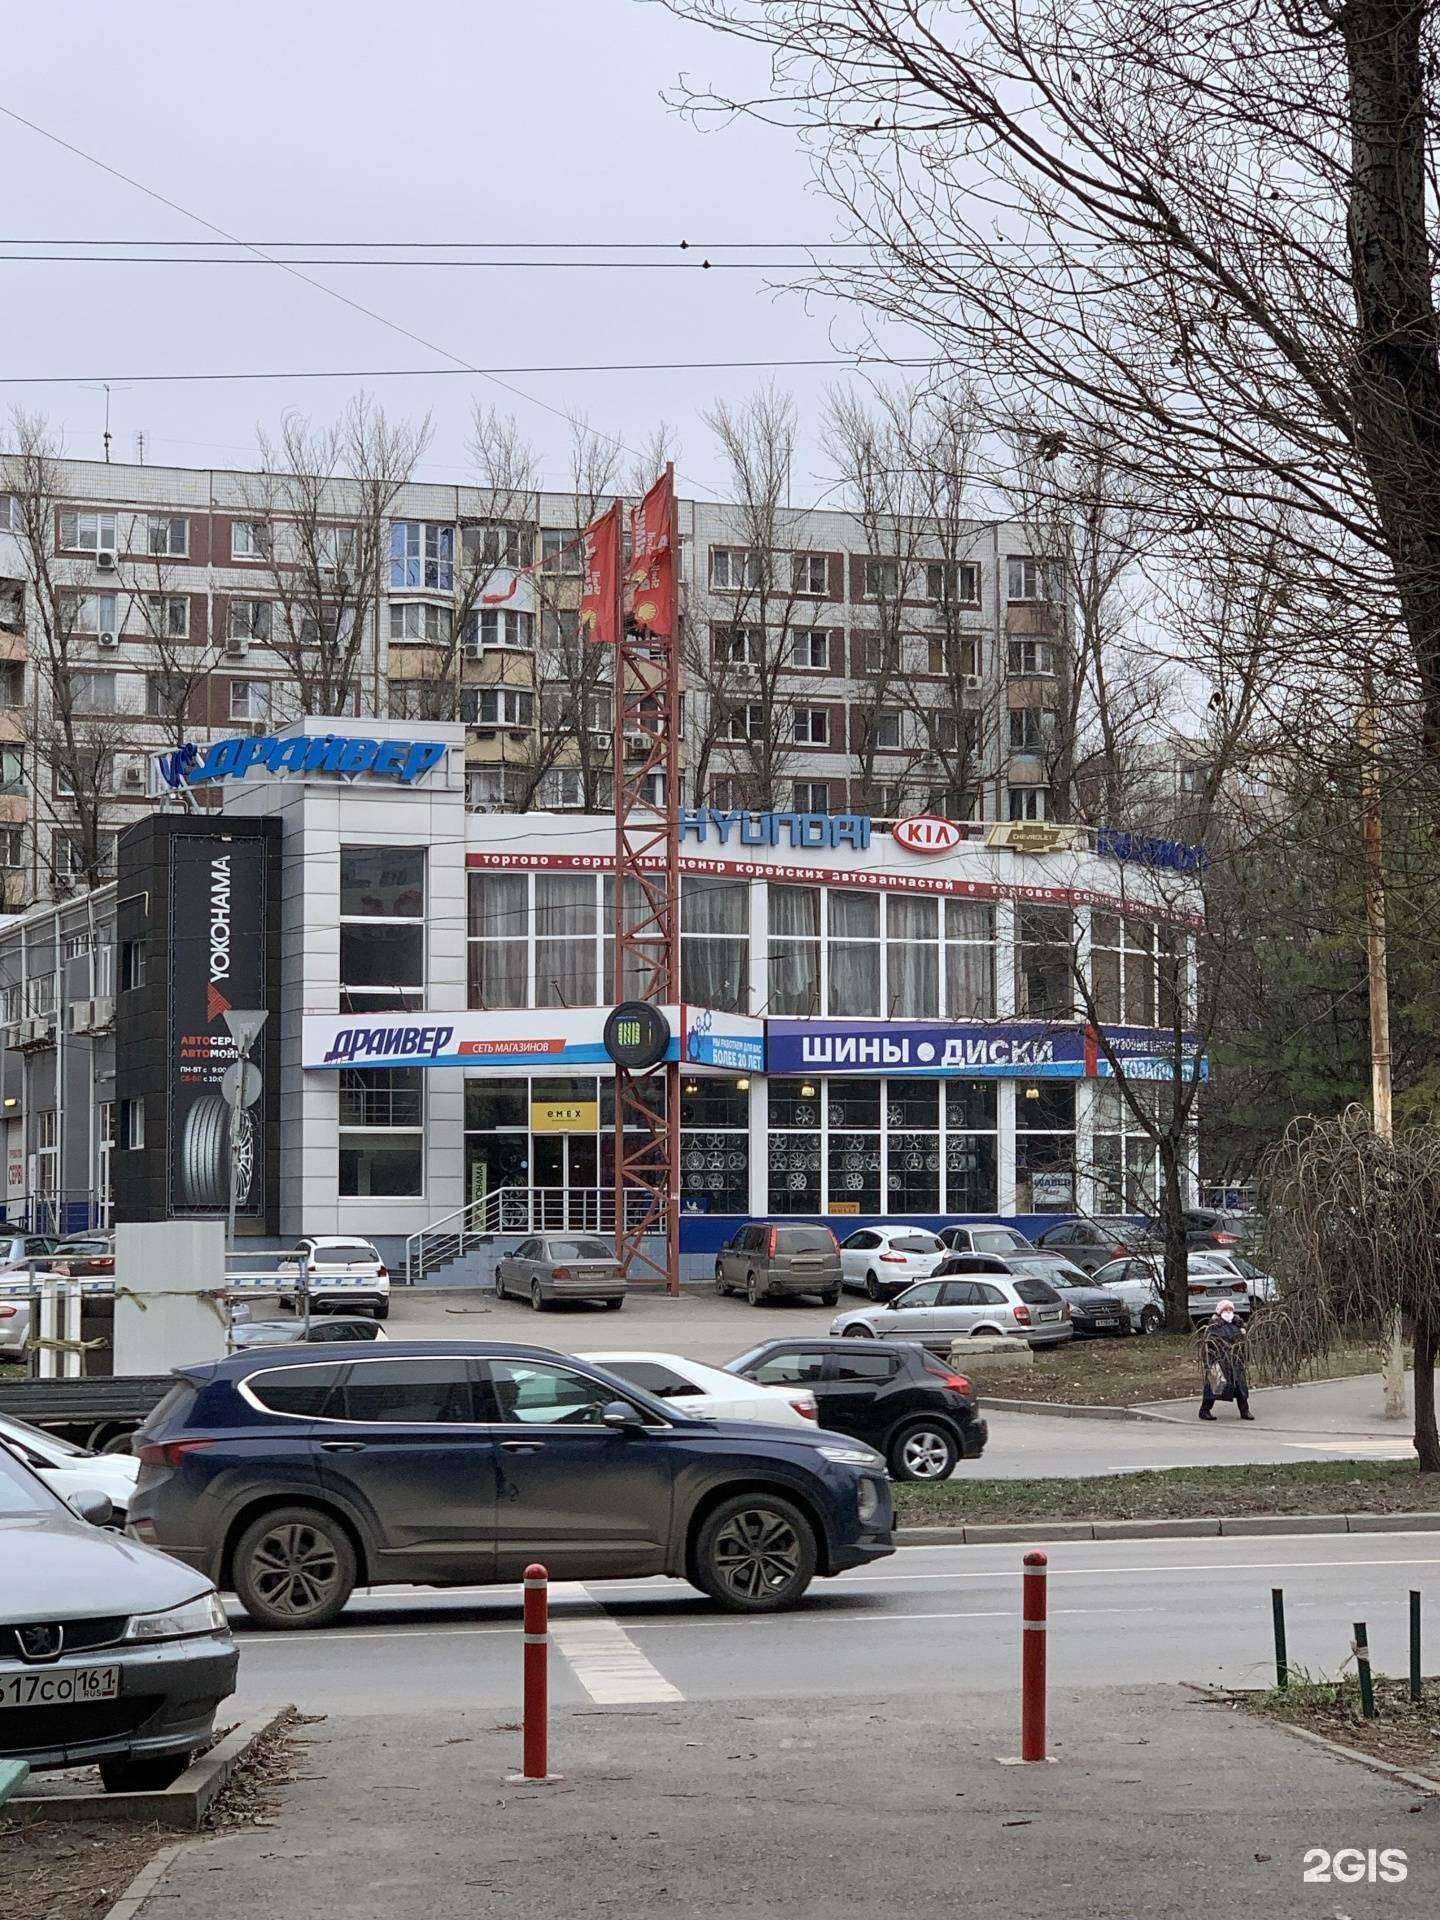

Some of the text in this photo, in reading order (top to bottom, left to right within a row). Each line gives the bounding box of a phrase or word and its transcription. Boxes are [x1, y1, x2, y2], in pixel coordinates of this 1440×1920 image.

[189, 734, 447, 783] ДРАЙВЕР
[679, 807, 871, 849] HYUNDAI
[907, 824, 951, 844] KIA
[483, 855, 549, 868] торгово
[572, 856, 667, 870] сервный
[678, 859, 725, 872] центр
[735, 863, 825, 880] корейских
[832, 871, 954, 891] автозапчастей
[210, 855, 231, 982] YOKOHAMA
[472, 1041, 549, 1054] СЕТЬ МАГАЗИНОВ
[737, 1053, 747, 1068] 20
[802, 1037, 1054, 1069] ШИНЫ ДИСКИ
[77, 1668, 113, 1690] 161
[83, 1690, 102, 1698] RUS
